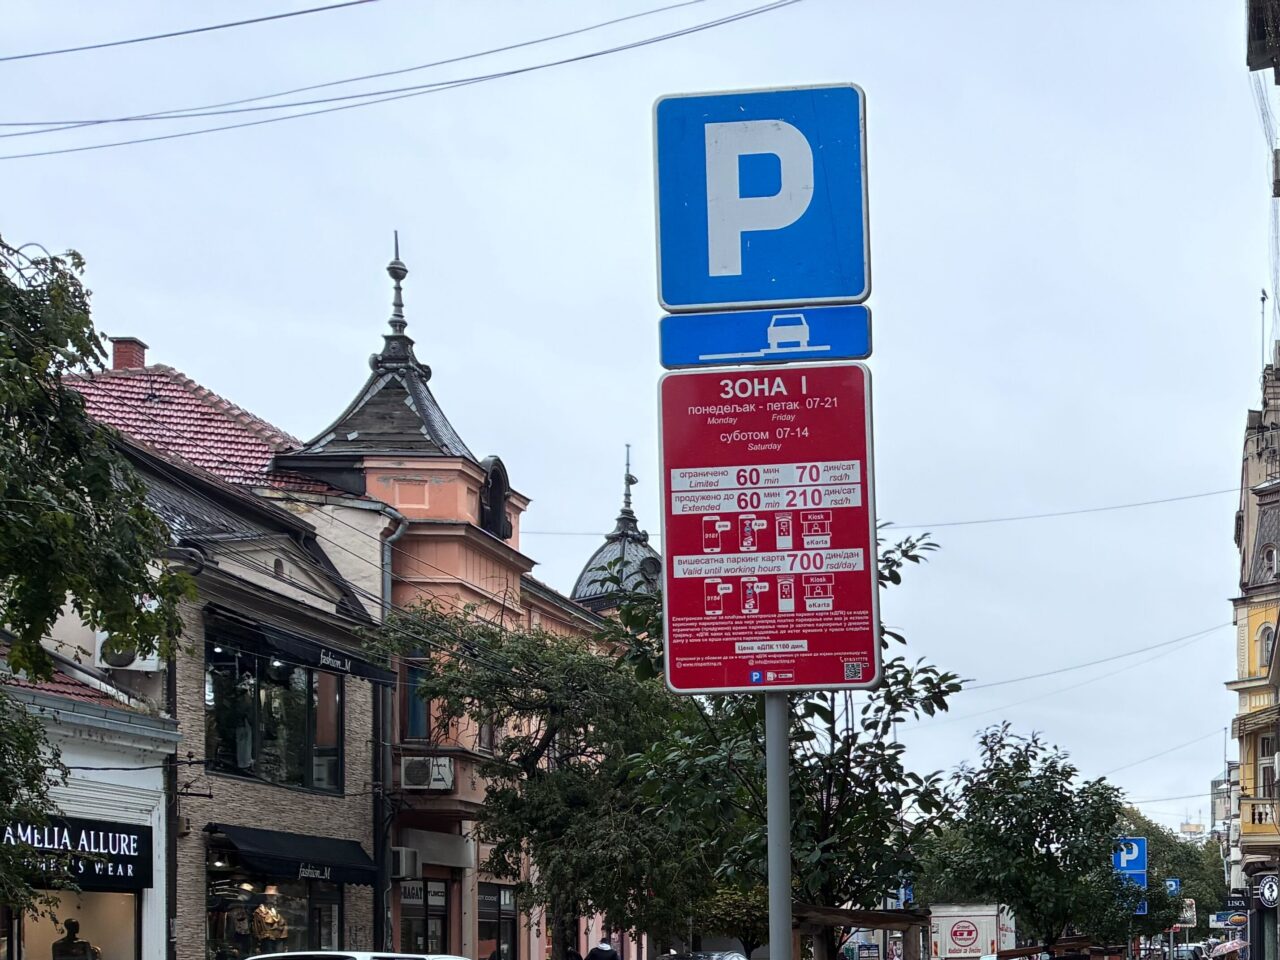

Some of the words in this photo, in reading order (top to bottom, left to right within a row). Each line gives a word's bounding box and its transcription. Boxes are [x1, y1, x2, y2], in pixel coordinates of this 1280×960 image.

[705, 119, 814, 277] P
[719, 376, 788, 399] ЗОНА
[801, 375, 807, 395] I
[688, 403, 756, 416] понедељак
[766, 401, 800, 411] петак
[805, 397, 838, 409] 07-21
[707, 416, 738, 425] Monday
[771, 413, 796, 422] Friday
[720, 429, 769, 444] суботом
[775, 426, 809, 439] 07-14
[747, 442, 782, 451] Saturday
[680, 470, 729, 479] ограничено
[736, 468, 760, 486] 60
[796, 465, 820, 483] 70
[823, 463, 856, 472] дин/сат
[689, 480, 719, 488] Limited
[829, 473, 850, 482] rsd/h
[675, 494, 722, 503] продужено
[723, 493, 735, 501] до
[737, 492, 761, 510] 60
[785, 488, 822, 508] 210
[823, 487, 856, 496] дин/сат
[681, 503, 721, 512] Extended
[830, 497, 851, 505] rsd/h
[677, 557, 724, 566] вишесатна
[726, 555, 759, 565] паркинг
[761, 555, 785, 563] карта
[787, 553, 824, 571] 700
[825, 551, 860, 561] дин/дан
[682, 566, 703, 576] Valid
[704, 566, 722, 575] until
[723, 565, 756, 575] working
[757, 564, 782, 573] hours
[826, 560, 857, 570] rsd/day
[752, 672, 760, 682] P
[2, 823, 72, 850] AMELIA
[78, 829, 139, 856] ALLURE
[1120, 842, 1139, 867] P
[94, 861, 134, 877] WEAR
